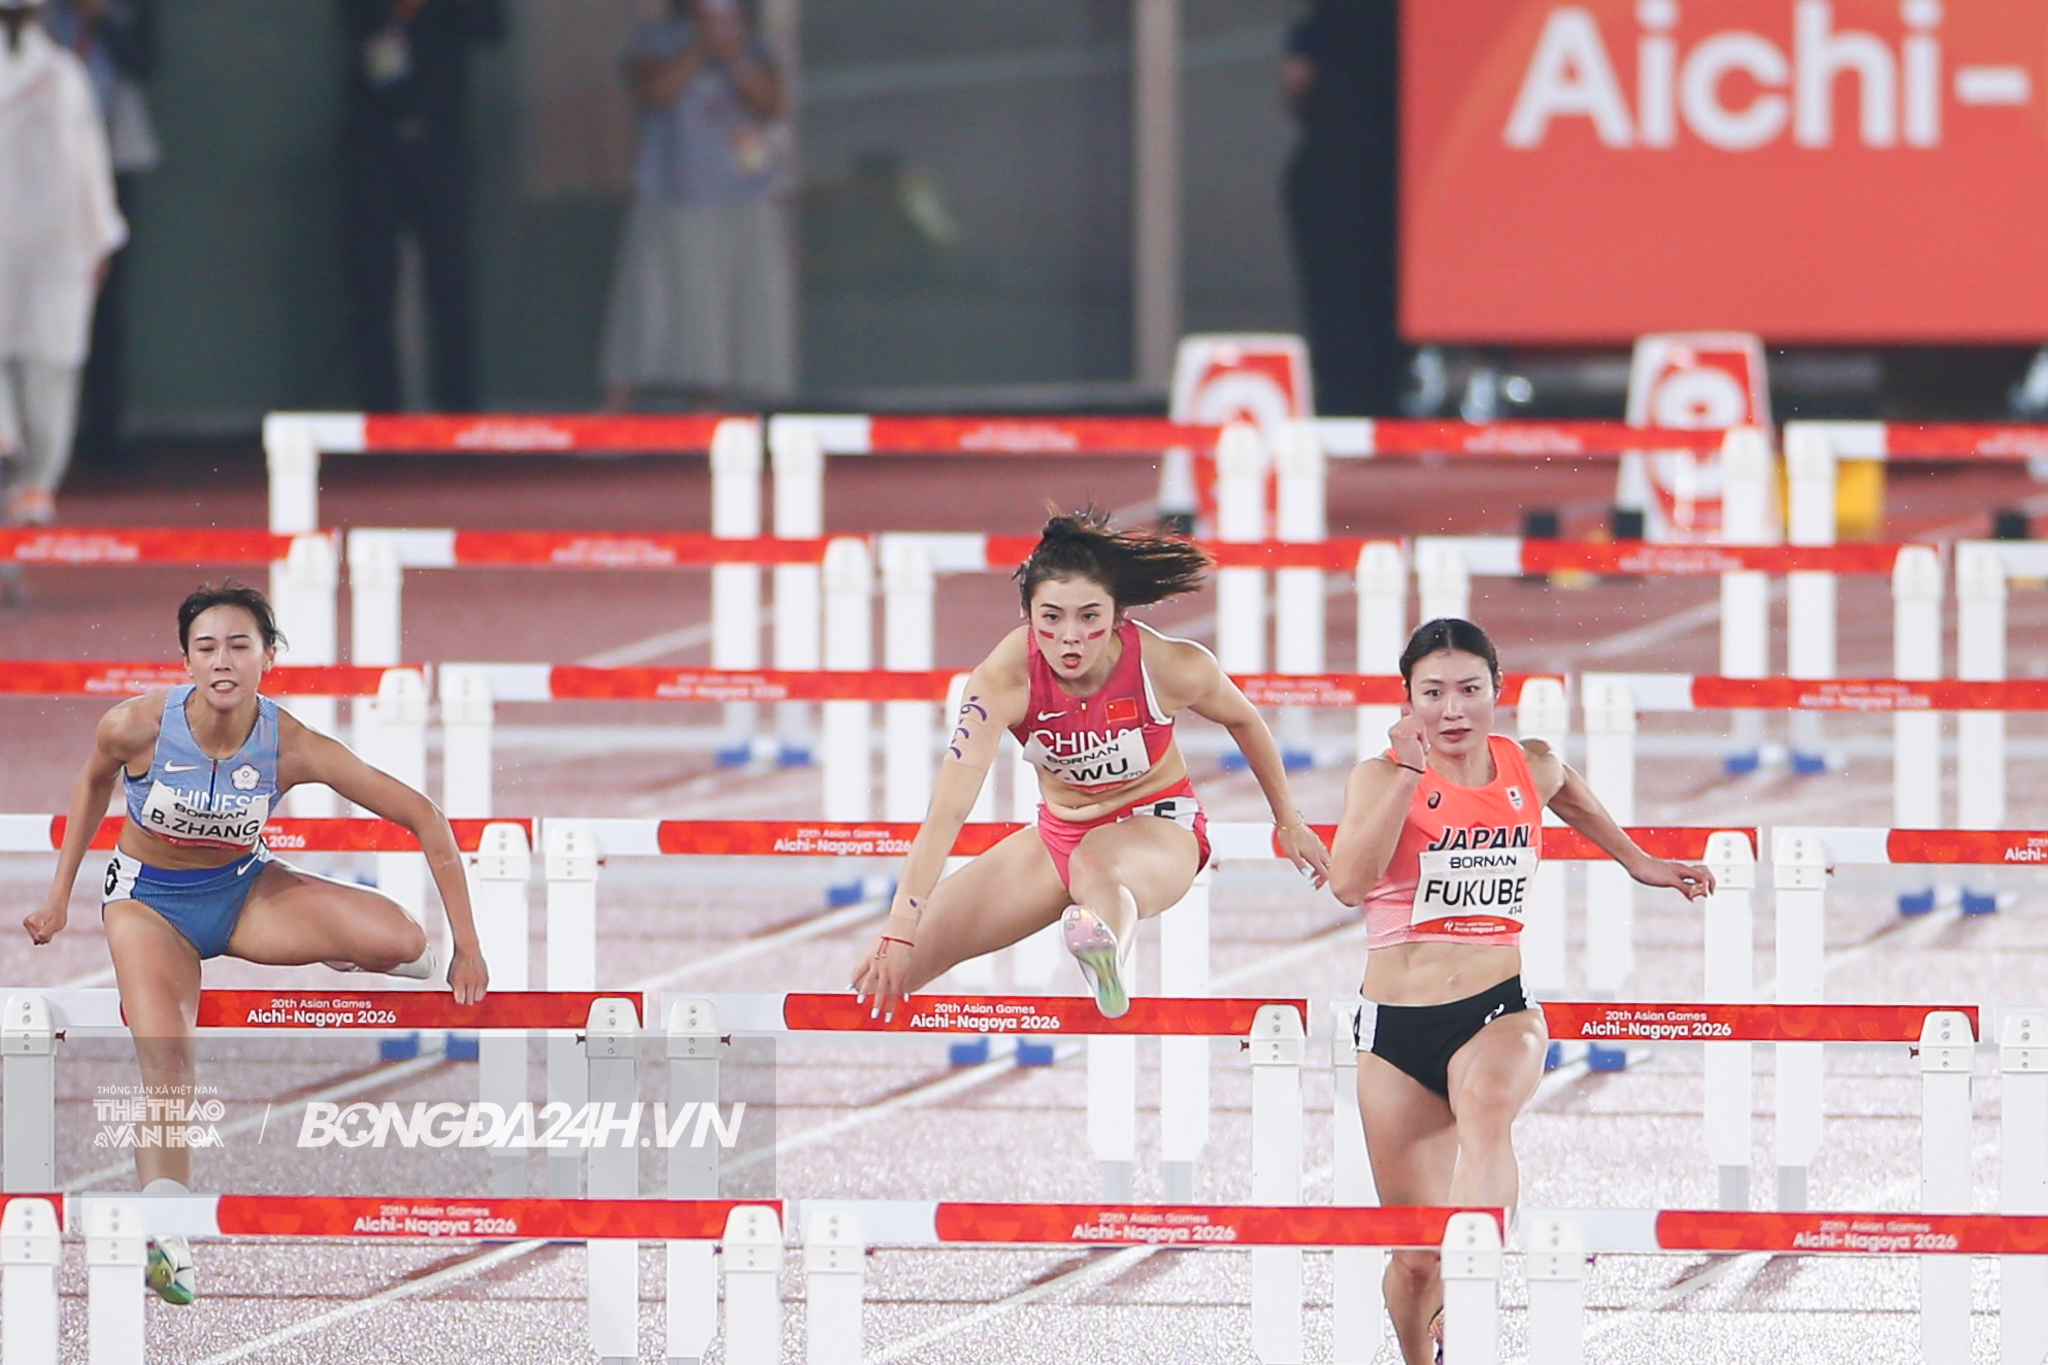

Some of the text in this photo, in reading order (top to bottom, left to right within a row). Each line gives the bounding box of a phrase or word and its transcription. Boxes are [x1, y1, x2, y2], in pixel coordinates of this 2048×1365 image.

[1503, 0, 2031, 150] Aichi-
[1046, 743, 1119, 765] BORNAN
[174, 802, 247, 820] BORNAN
[151, 808, 260, 838] B.ZHANG
[269, 835, 306, 848] 2026
[774, 838, 912, 855] Aichi-Nagoya 2026
[1428, 823, 1529, 851] JAPAN
[1449, 855, 1517, 869] BORNAN
[1424, 876, 1527, 907] FUKUBE
[271, 998, 372, 1009] 20th Asian Games
[934, 1003, 1035, 1014] 20th Asian Games
[247, 1008, 396, 1027] Aichi-Nagoya 2026
[910, 1013, 1060, 1032] Aichi-Nagoya 2026
[1606, 1011, 1707, 1021] 20th Asian Games
[1581, 1021, 1732, 1039] Aichi-Nagoya 2026
[353, 1215, 518, 1237] Aichi-Nagoya 2026
[1071, 1223, 1237, 1243] Aichi-Nagoya 2026
[1793, 1231, 1958, 1252] Aichi-Nagoya 2026
